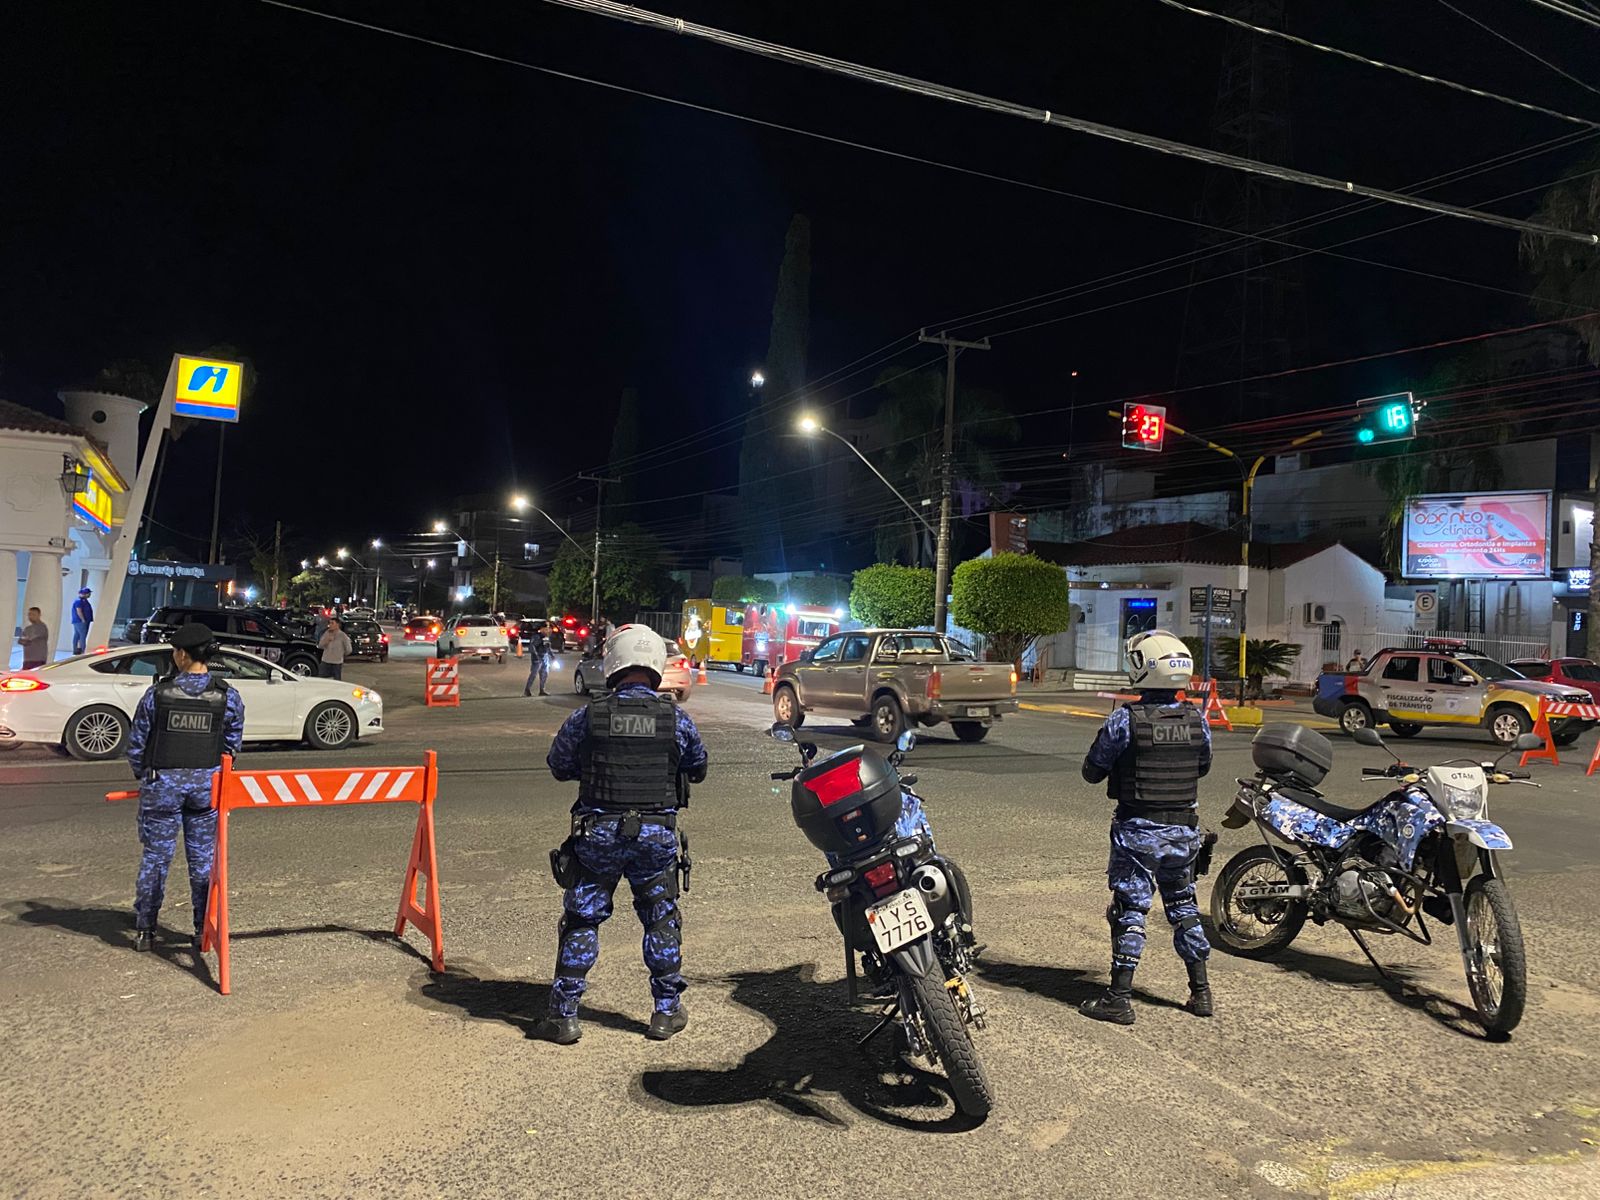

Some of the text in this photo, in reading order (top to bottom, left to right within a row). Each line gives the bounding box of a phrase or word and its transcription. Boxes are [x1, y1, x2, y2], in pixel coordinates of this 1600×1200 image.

[1387, 405, 1407, 428] 16
[1140, 415, 1160, 440] 23
[1422, 596, 1430, 608] E
[1386, 694, 1434, 703] FISCALIZAÇÃO
[1399, 701, 1433, 710] TRÂNSITO
[171, 714, 209, 730] CANIL
[612, 716, 656, 735] GTAM
[1154, 725, 1191, 742] GTAM
[1249, 886, 1290, 896] GTAM
[879, 901, 917, 929] IYS
[881, 915, 928, 947] 7776
